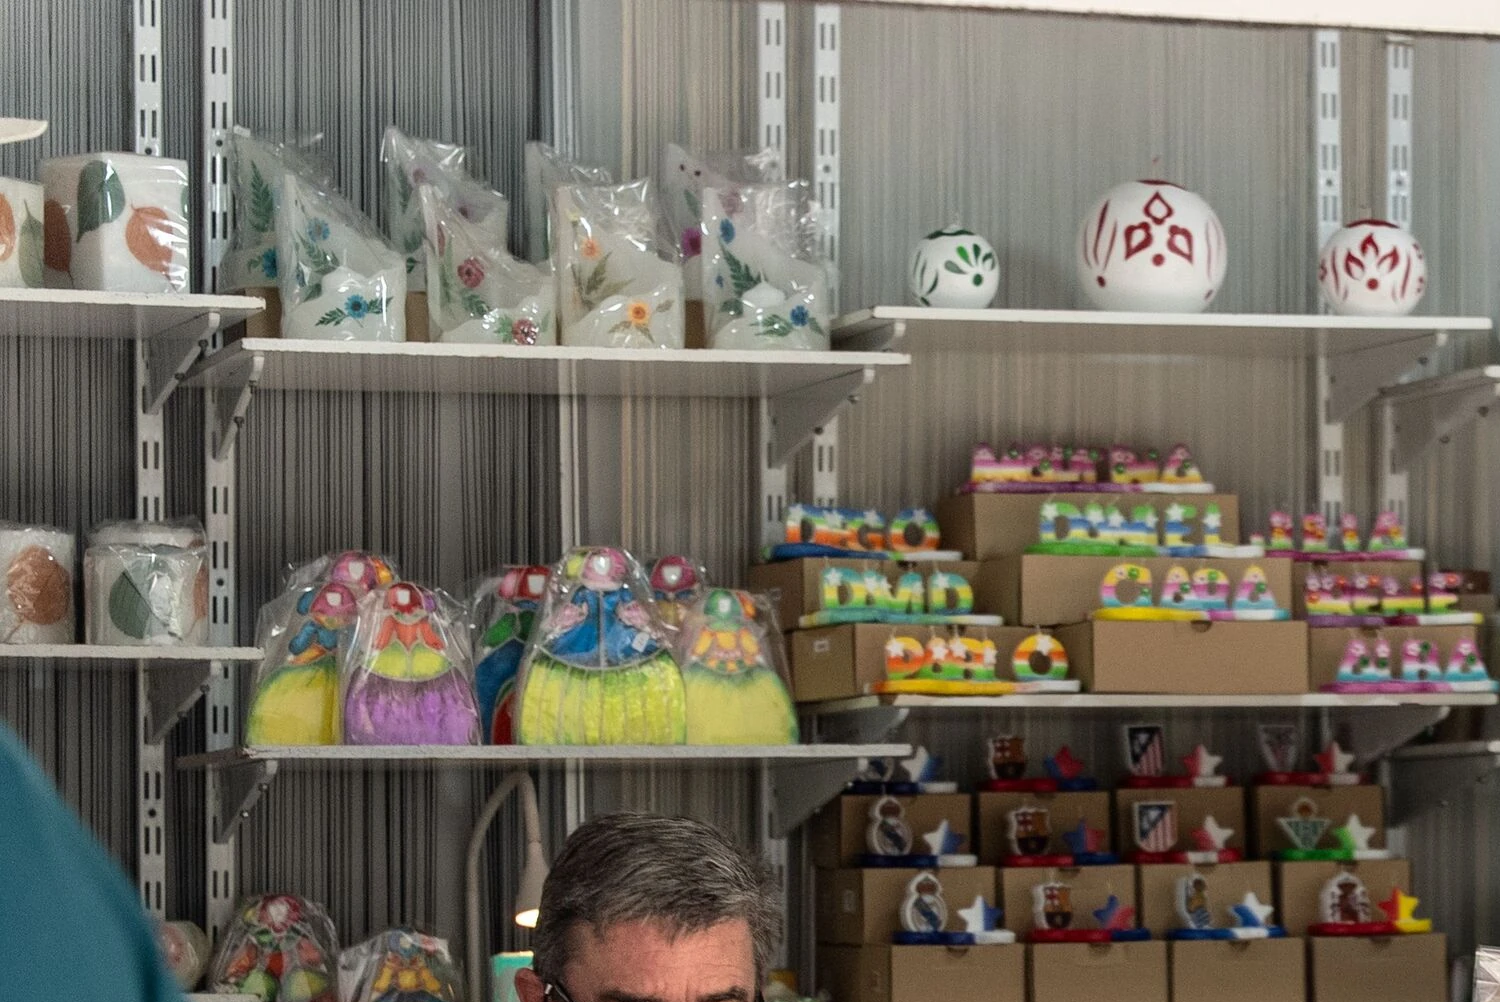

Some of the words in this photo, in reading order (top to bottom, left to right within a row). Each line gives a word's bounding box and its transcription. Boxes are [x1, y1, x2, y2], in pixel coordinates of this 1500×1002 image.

[785, 504, 940, 552] DIEGO
[1040, 501, 1222, 546] DANIEL
[822, 567, 974, 613] DAVID
